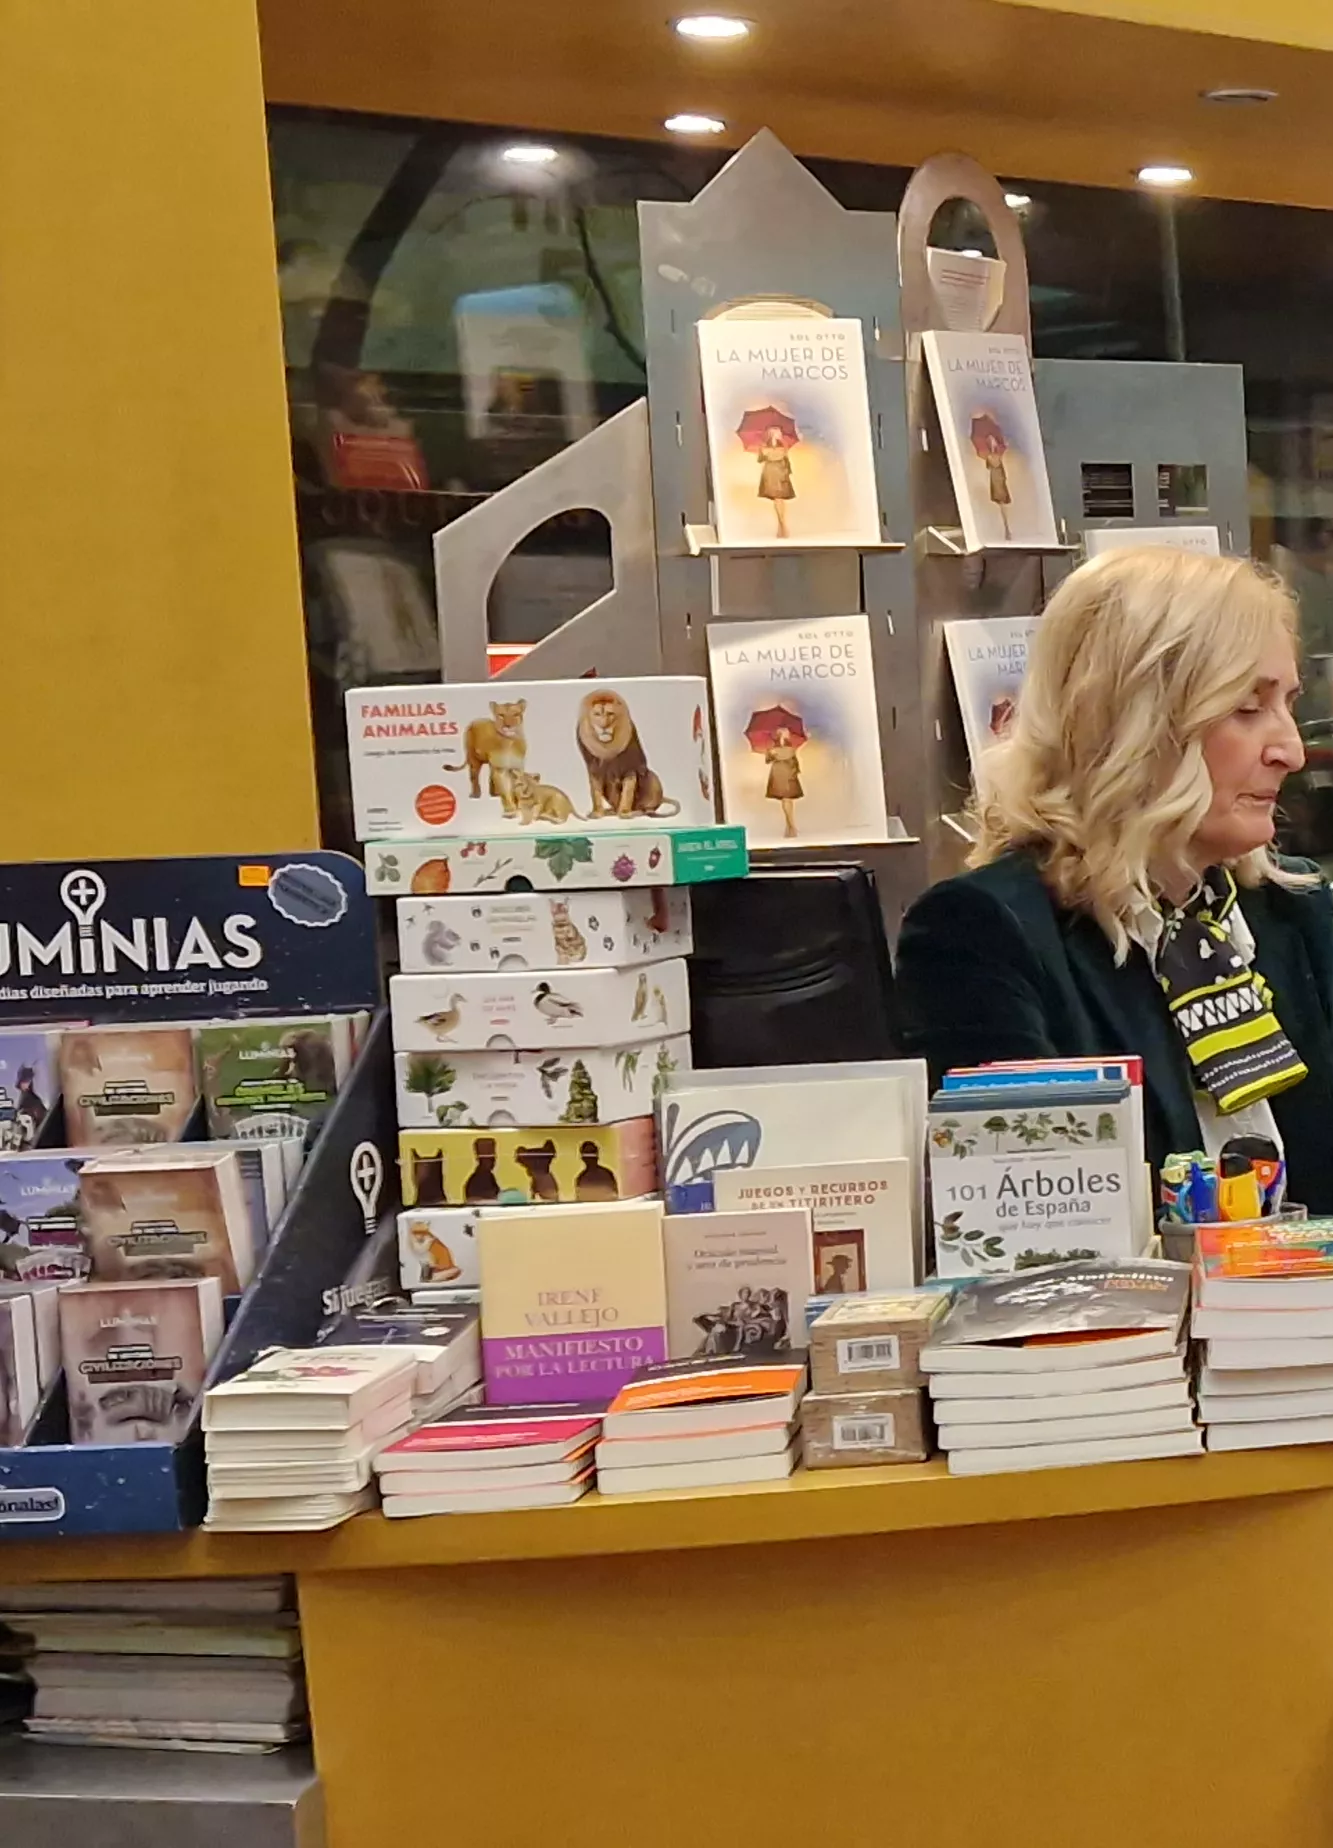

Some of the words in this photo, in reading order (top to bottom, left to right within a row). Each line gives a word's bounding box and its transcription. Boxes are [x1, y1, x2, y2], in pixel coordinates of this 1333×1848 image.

[716, 348, 741, 364] LA
[748, 346, 813, 363] MUJER
[821, 346, 847, 362] DE
[761, 364, 849, 381] MARCOS
[947, 358, 963, 371] LA
[965, 360, 1006, 375] MUJER
[724, 649, 749, 666] LA
[757, 646, 822, 663] MUJER
[829, 643, 855, 660] DE
[967, 646, 984, 661] LA
[769, 662, 857, 681] MARCOS
[361, 702, 447, 719] FAMILIAS
[362, 721, 459, 738] ANIMALES
[0, 914, 262, 977] MINIAS
[30, 983, 103, 999] diseñadas
[105, 983, 138, 998] para
[141, 980, 206, 997] aprender
[207, 978, 269, 996] jugando
[737, 1184, 795, 1199] JUEGOS
[798, 1185, 807, 1195] Y
[810, 1179, 889, 1196] RECURSOS
[946, 1184, 987, 1202] 101
[995, 1166, 1122, 1200] Árboles
[789, 1193, 876, 1209] TITIRITERO
[995, 1201, 1020, 1218] de
[1025, 1198, 1092, 1219] España
[1021, 1217, 1041, 1231] hay
[538, 1287, 604, 1307] IRENE
[523, 1306, 619, 1329] VALLEJO
[504, 1335, 644, 1361] MANIFIESTO
[496, 1361, 536, 1380] POR
[538, 1360, 565, 1378] LA
[568, 1354, 656, 1375] LECTURA
